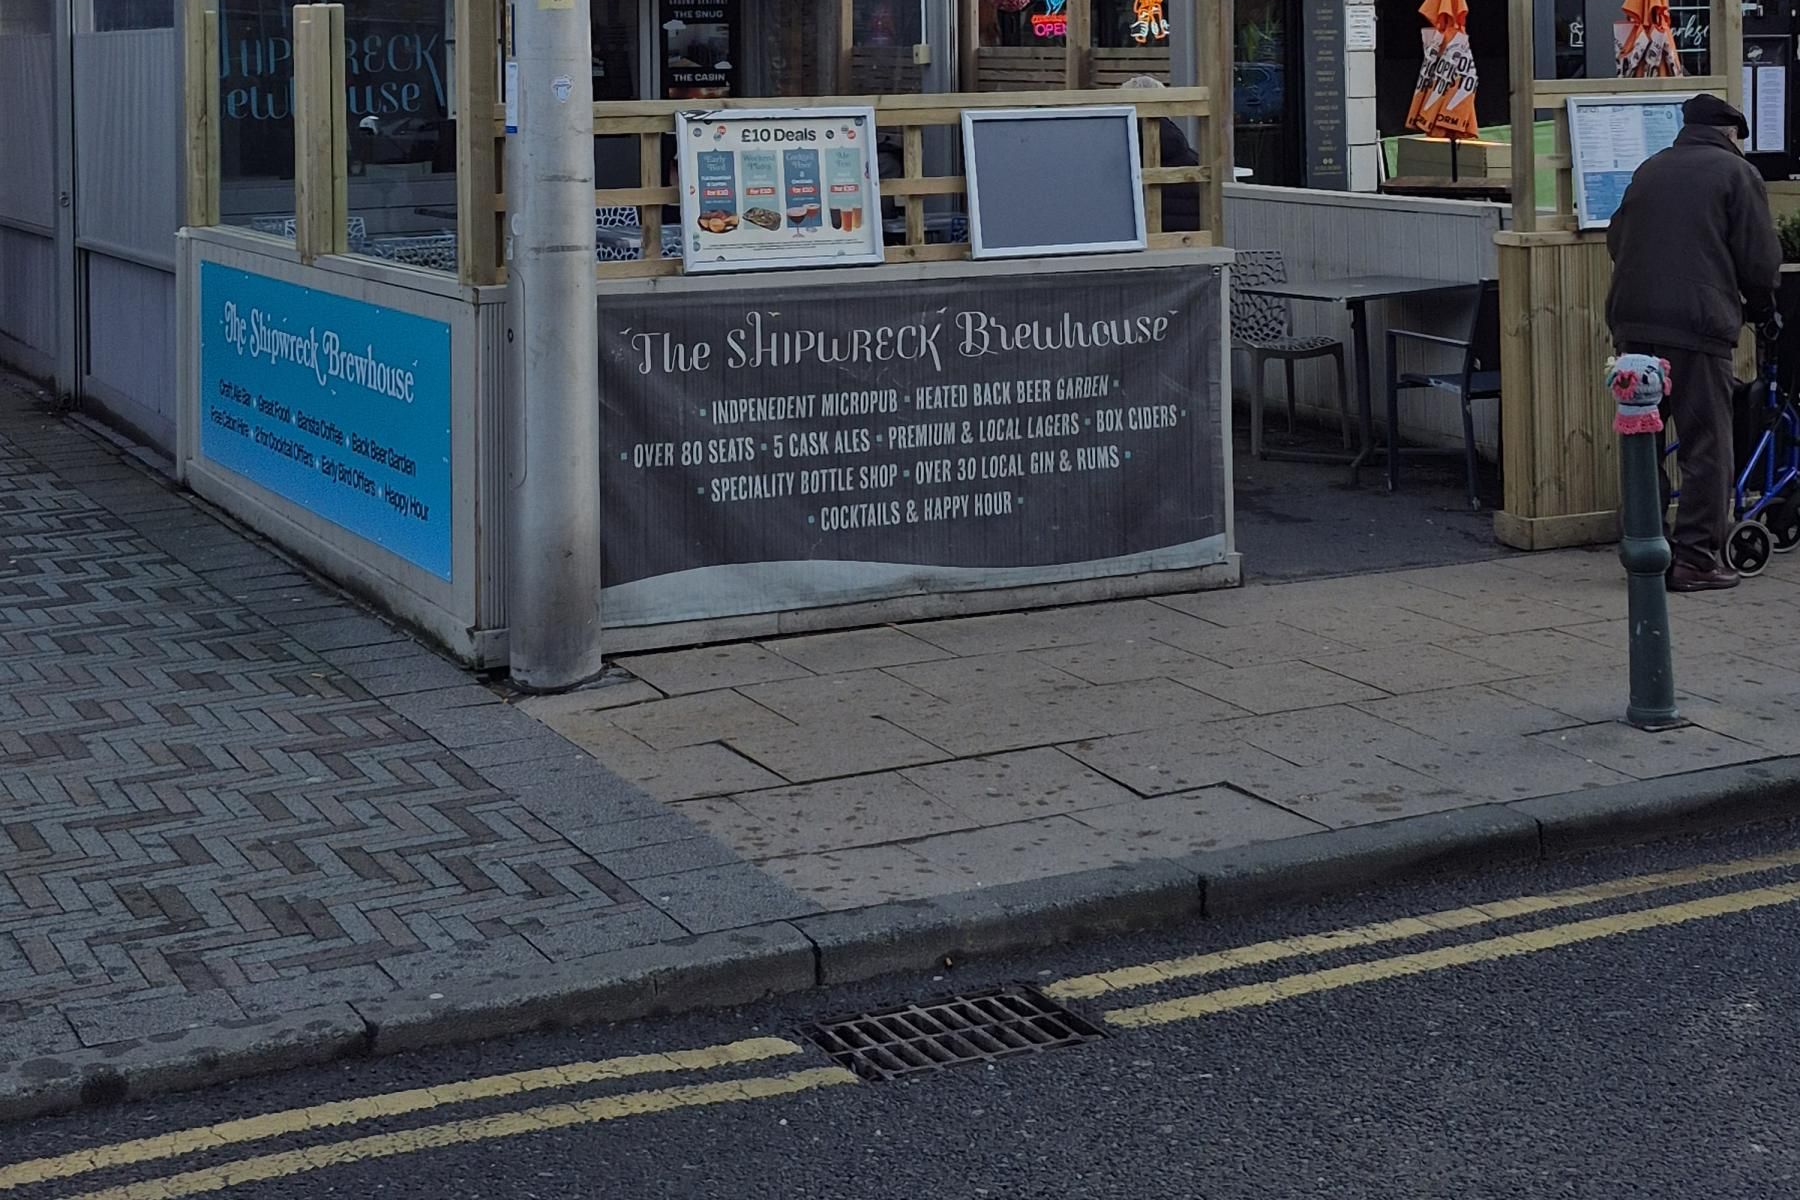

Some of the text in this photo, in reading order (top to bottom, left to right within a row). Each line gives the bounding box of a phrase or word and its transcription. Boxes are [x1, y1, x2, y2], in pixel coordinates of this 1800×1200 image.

[673, 10, 724, 19] THE SNUG
[672, 73, 726, 82] THE CABIN
[741, 128, 817, 143] £10 Deals
[224, 301, 415, 403] The Shipwreck Brewhouse
[631, 331, 711, 375] The
[956, 309, 1170, 358] Brewhouse
[712, 375, 1110, 425] INDPENEDENT MICROPUB HEATED BACK BEER GARDEN
[297, 409, 320, 436] Barista
[320, 419, 344, 446] Coffee
[352, 431, 369, 457] Back
[370, 439, 388, 464] Beer
[388, 448, 417, 477] Garden
[633, 405, 1179, 469] OVER 80 SEATS 5 CASK ALES PREMIUM & LOCAL LAGERS BOX CIDERS
[293, 442, 314, 467] Offers
[352, 469, 376, 496] Offers
[384, 482, 409, 516] Happy
[410, 494, 430, 521] Hour
[711, 445, 1120, 503] SPECIALITY BOTTLE SHOP OVER 30 LOCAL GIN & RUMS
[821, 491, 1013, 532] COCKTAILS & HAPPY HOUR
